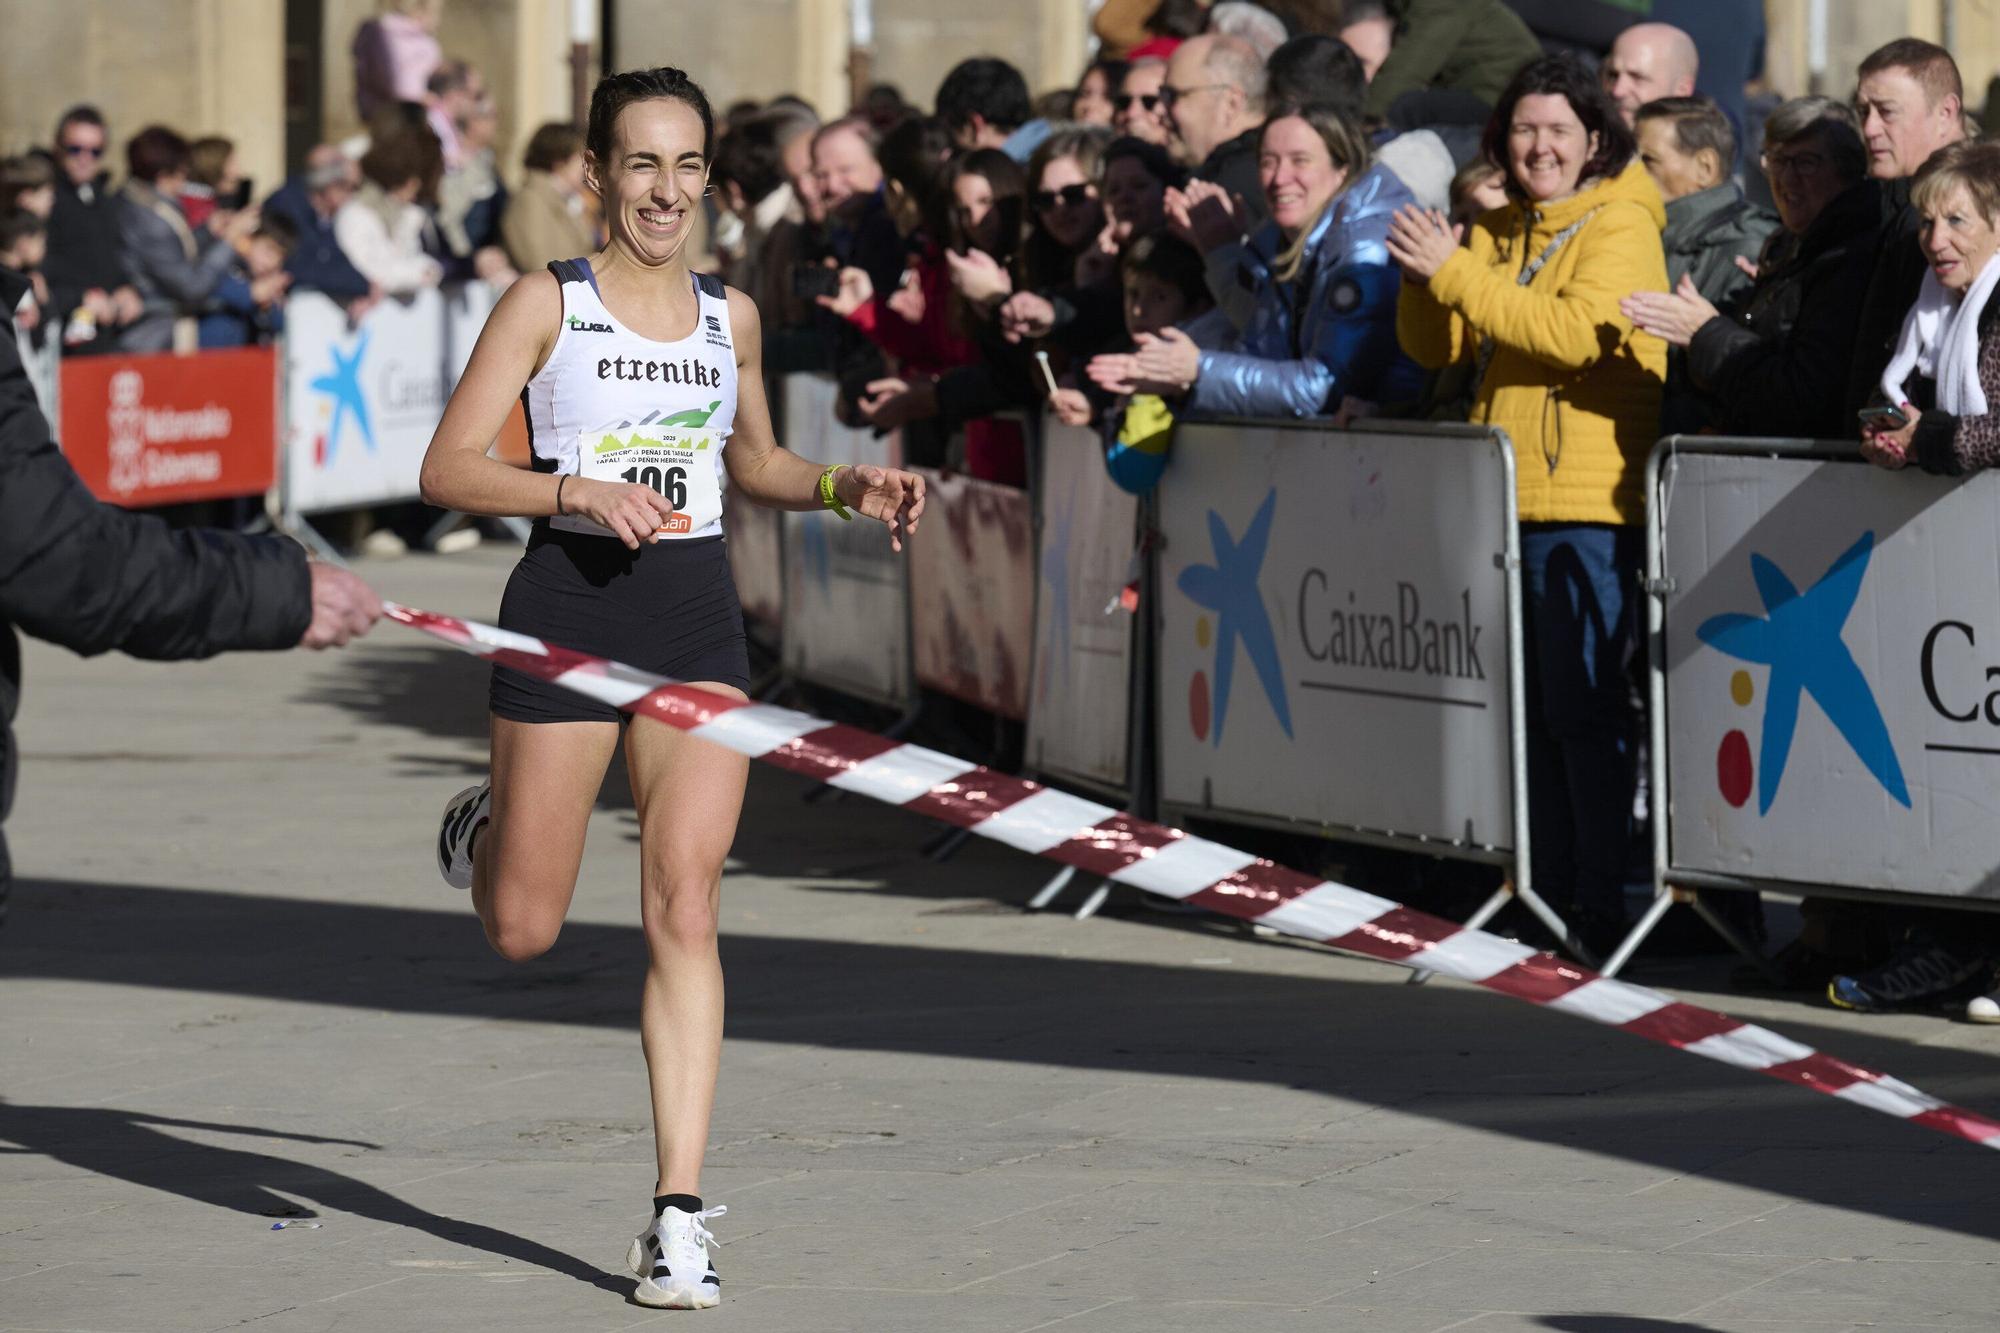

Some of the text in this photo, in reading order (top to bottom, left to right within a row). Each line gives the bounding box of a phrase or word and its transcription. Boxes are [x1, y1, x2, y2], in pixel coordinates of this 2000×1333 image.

[570, 321, 615, 334] LUGA
[596, 354, 722, 390] etxenike
[1297, 567, 1486, 681] CaixaBank
